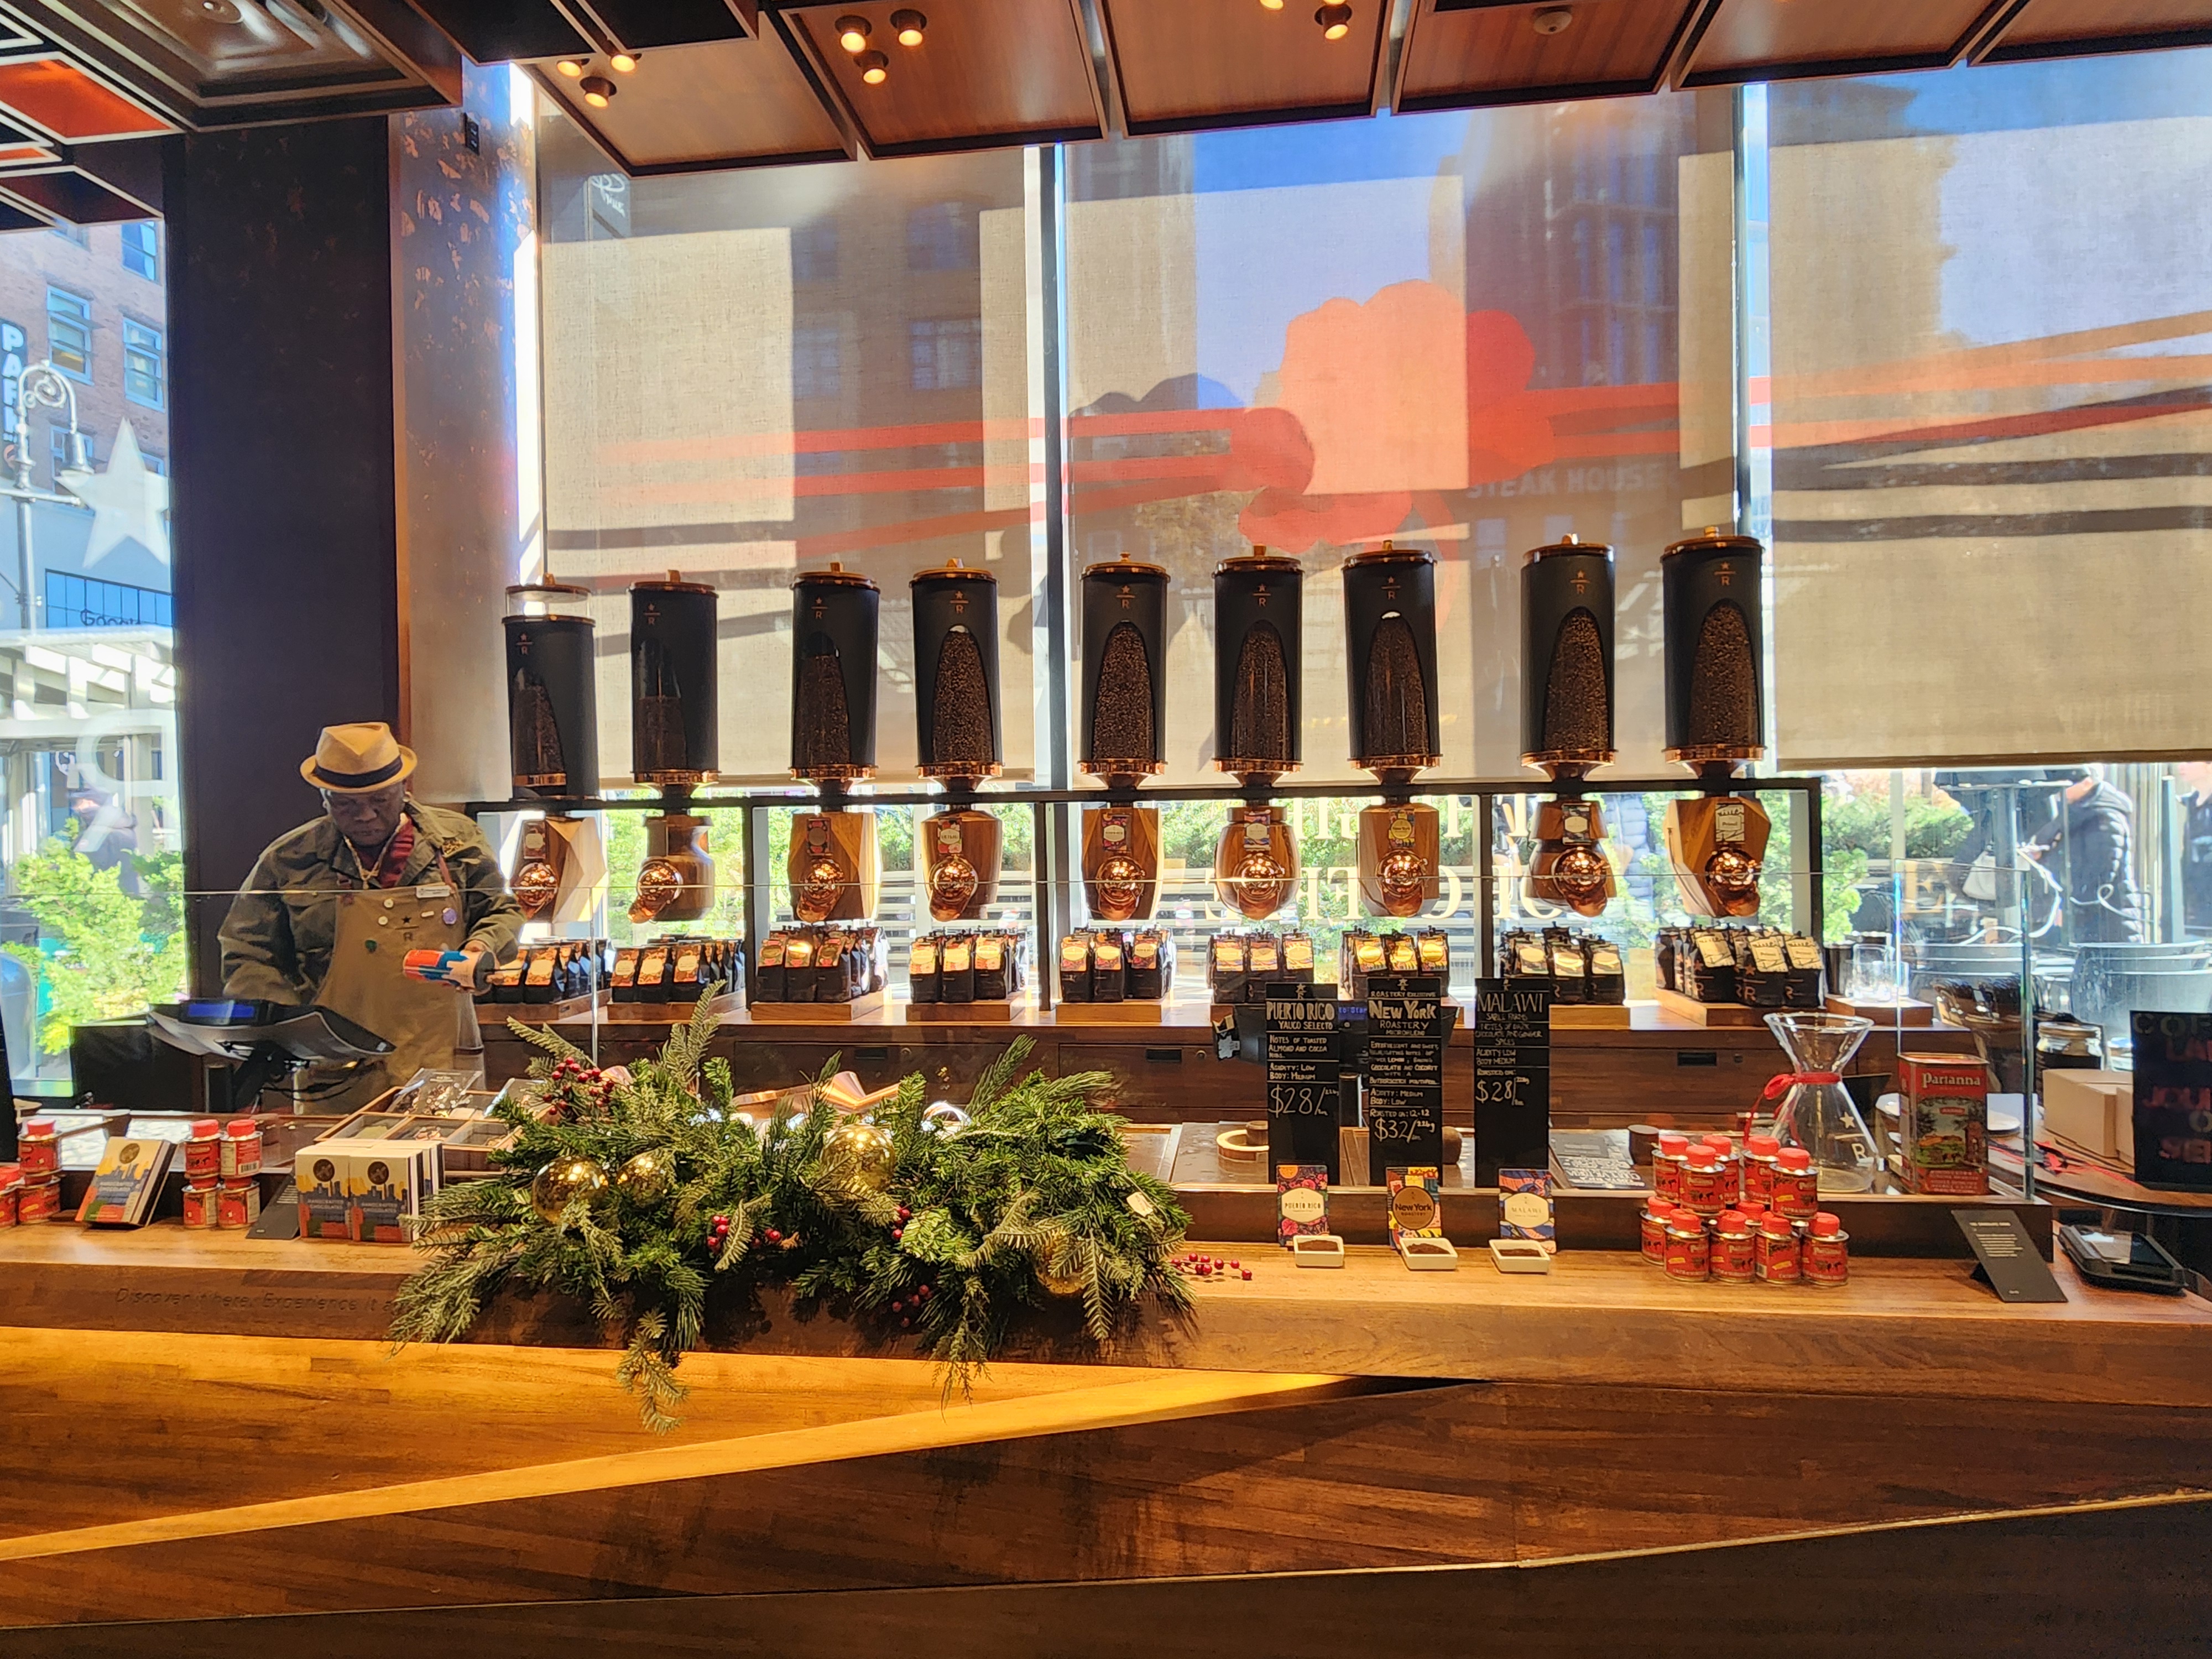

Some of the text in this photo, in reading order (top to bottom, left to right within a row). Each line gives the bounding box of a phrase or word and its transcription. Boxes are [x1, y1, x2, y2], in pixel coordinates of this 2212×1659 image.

[1567, 463, 1662, 492] HOUSE
[1266, 1002, 1335, 1021] PUERTO RICO
[1477, 993, 1543, 1013] MALAWI
[1278, 1021, 1333, 1030] YAUCO SELECTO
[1380, 1020, 1430, 1030] ROASTERY
[1270, 1035, 1290, 1044] NOTES
[1921, 1072, 1981, 1089] Partanna
[1370, 1097, 1390, 1105] BODY:
[115, 1287, 190, 1306] Discover
[262, 1292, 357, 1311] Experience
